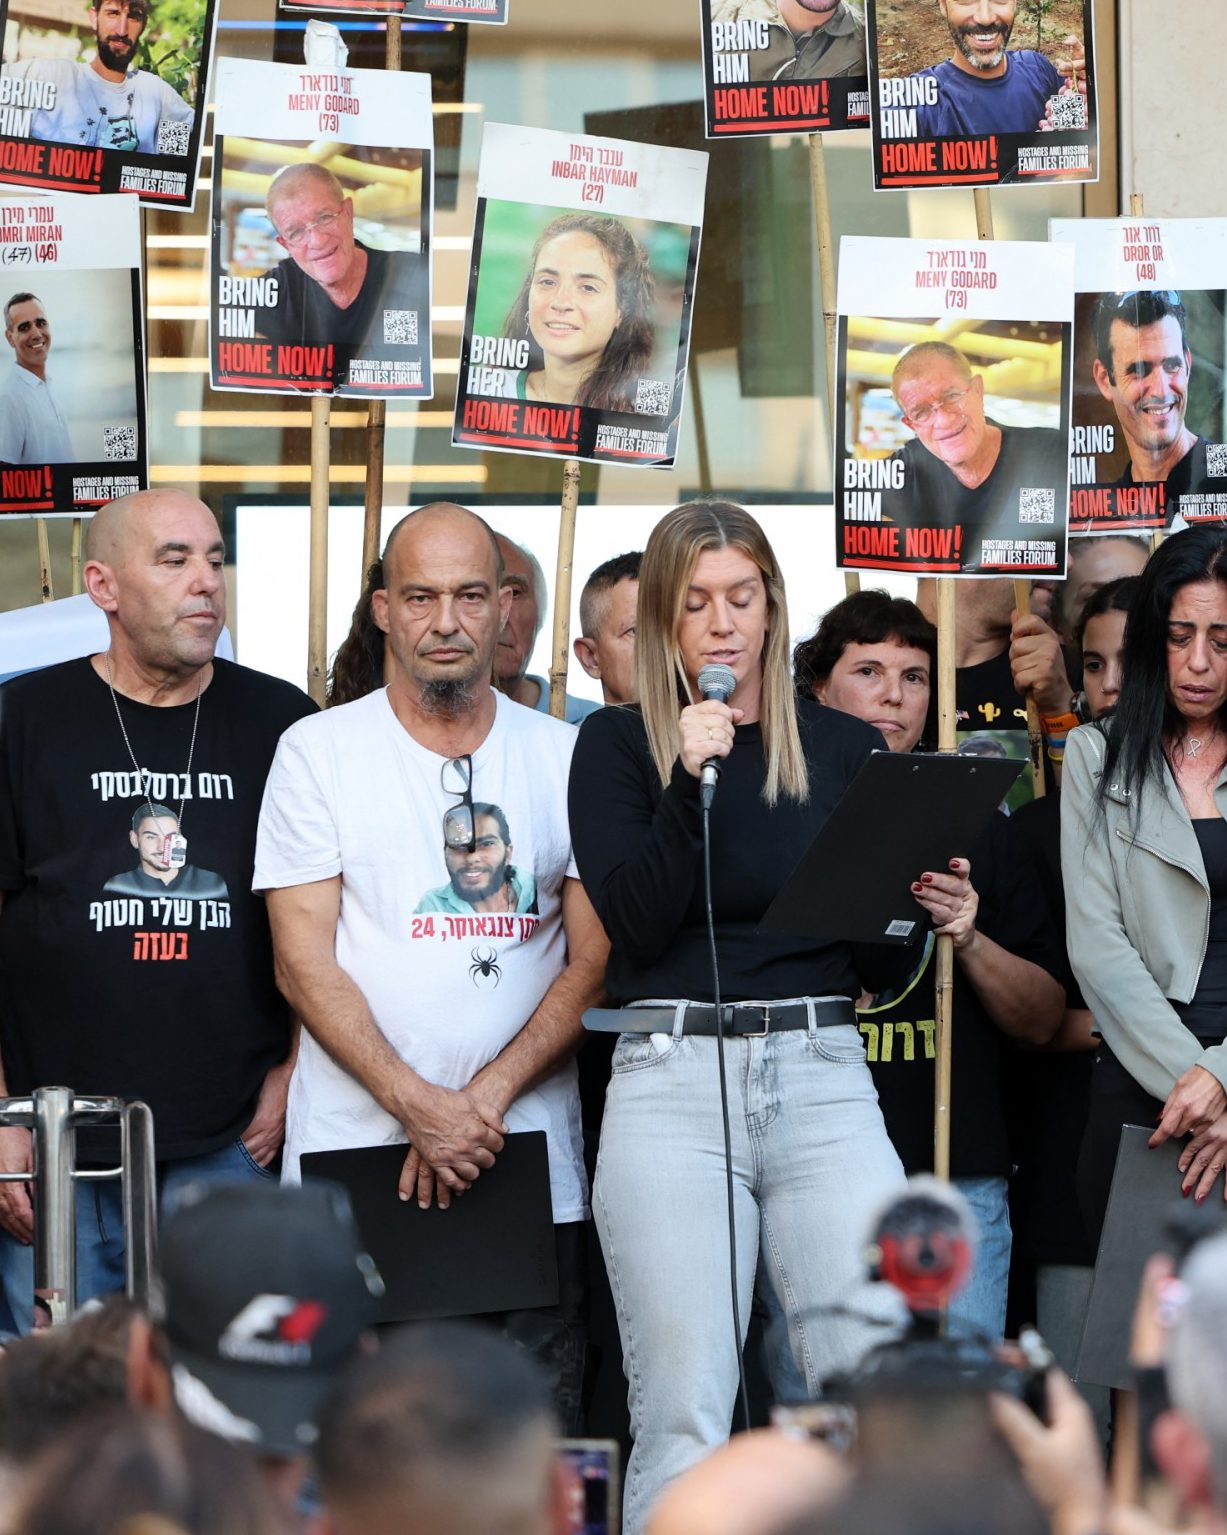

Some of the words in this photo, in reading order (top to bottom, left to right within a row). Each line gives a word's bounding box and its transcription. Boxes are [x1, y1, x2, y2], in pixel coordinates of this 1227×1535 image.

[711, 21, 768, 51] BRING
[713, 53, 749, 83] HIM
[299, 75, 339, 92] גודארד
[879, 77, 937, 107] BRING
[289, 94, 320, 111] MENY
[325, 96, 359, 116] GODARD
[714, 87, 768, 119] HOME
[773, 80, 829, 116] NOW!
[319, 114, 339, 133] (73)
[881, 109, 917, 138] HIM
[49, 147, 103, 182] NOW!
[570, 144, 593, 162] הימן
[597, 148, 623, 166] ענבר
[881, 142, 936, 173] HOME
[942, 136, 997, 171] NOW!
[1018, 156, 1057, 171] FAMILIES
[1058, 155, 1088, 170] FORUM
[552, 161, 586, 180] INBAR
[590, 166, 637, 187] HAYMAN
[582, 183, 604, 204] (27)
[2, 208, 24, 225] מירן
[28, 207, 54, 222] עמרי
[27, 225, 62, 242] MIRAN
[1123, 227, 1141, 243] אור
[2, 247, 31, 264] (47)
[927, 251, 966, 268] גודארד
[970, 251, 986, 269] מני
[1123, 245, 1150, 262] DROR
[1153, 245, 1163, 262] OR
[916, 271, 946, 288] MENY
[951, 271, 997, 289] GODARD
[1137, 263, 1156, 281] (48)
[219, 276, 278, 308] BRING
[945, 291, 967, 310] (73)
[219, 308, 255, 338] HIM
[219, 342, 273, 374] HOME
[278, 344, 333, 378] NOW!
[471, 335, 529, 368] BRING
[350, 370, 388, 384] FAMILIES
[390, 371, 421, 385] FORUM
[467, 367, 504, 396] HER
[463, 400, 518, 433] HOME
[523, 406, 580, 440] NOW!
[596, 435, 635, 452] FAMILIES
[636, 439, 667, 456] FORUM
[2, 466, 53, 498] NOW!
[844, 459, 905, 489] BRING
[844, 492, 881, 521] HIM
[1116, 483, 1165, 516] NOW!
[844, 525, 899, 556] HOME
[905, 525, 962, 559] NOW!
[981, 550, 1022, 564] FAMILIES
[1024, 551, 1055, 565] FORUM
[91, 768, 193, 801] ברסלבסקי
[198, 773, 234, 799] רום
[89, 899, 143, 931] חטוף
[151, 898, 192, 926] שלי
[199, 901, 231, 930] הבן
[412, 917, 434, 938] 24
[134, 932, 189, 960] בעזה
